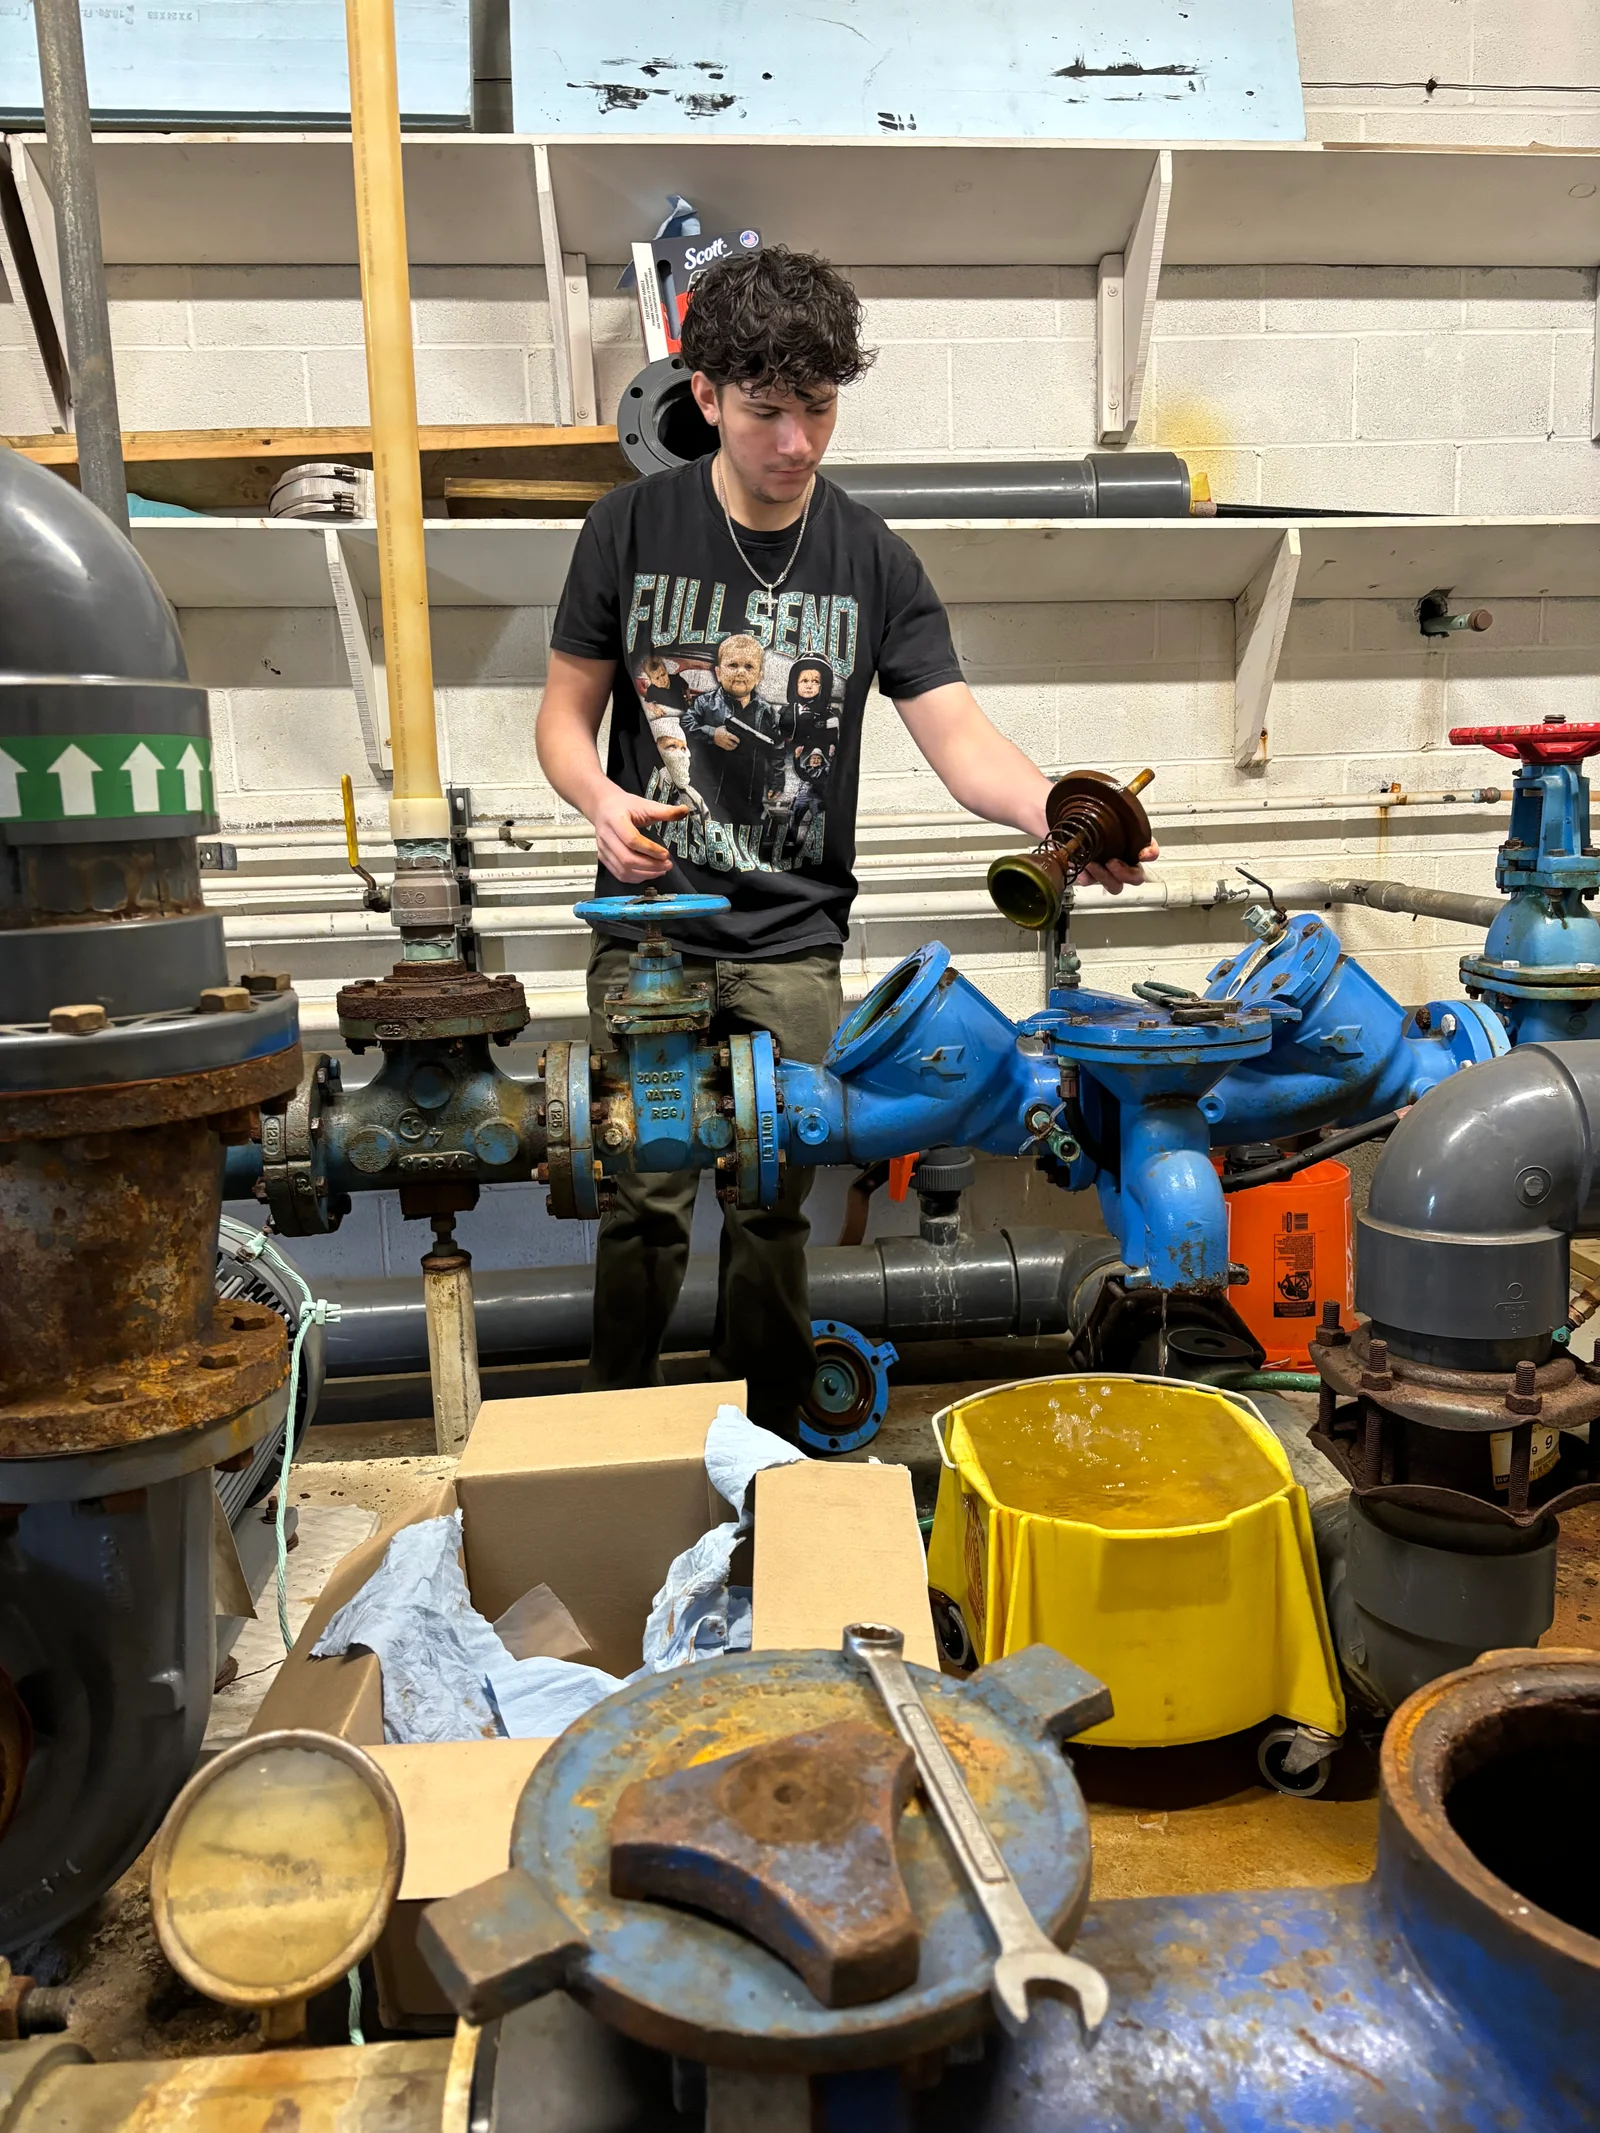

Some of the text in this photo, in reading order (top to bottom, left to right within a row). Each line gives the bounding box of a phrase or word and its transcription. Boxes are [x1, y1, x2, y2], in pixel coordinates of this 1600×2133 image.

[684, 237, 726, 270] Scott
[626, 572, 859, 680] FULL SEND
[636, 1071, 660, 1084] 200
[645, 1088, 682, 1102] WATTS
[651, 1106, 678, 1120] REG
